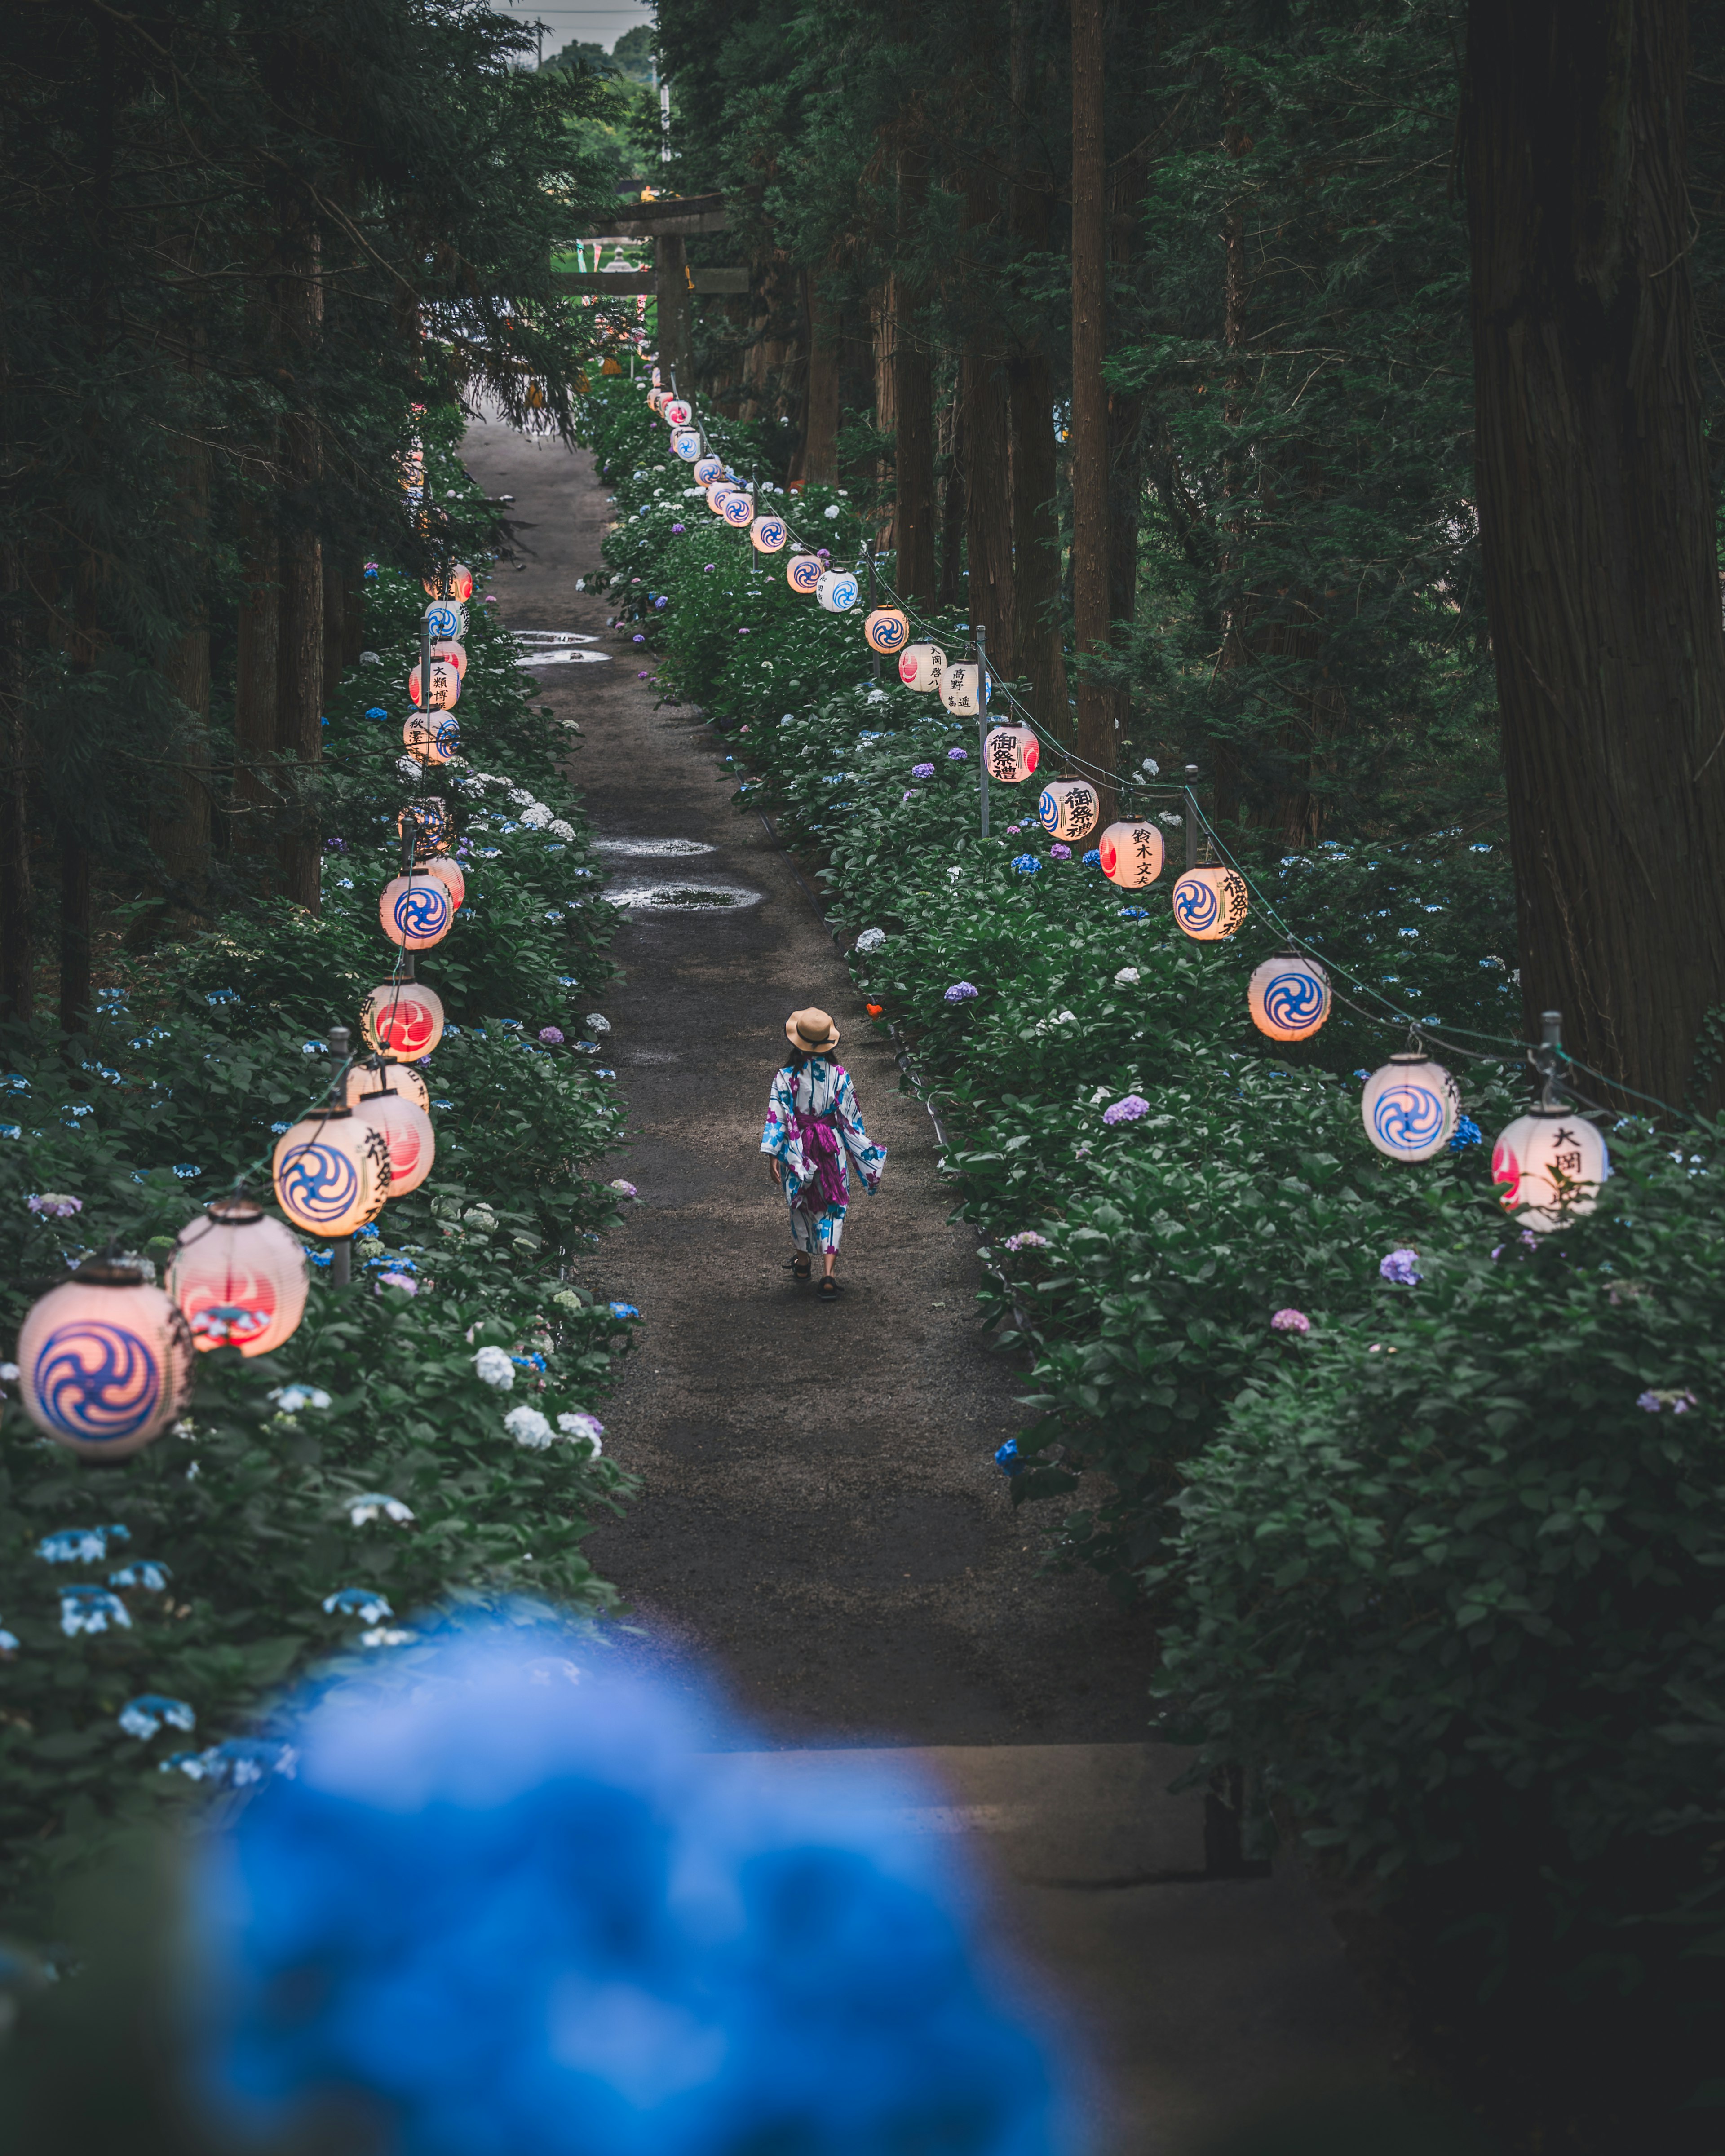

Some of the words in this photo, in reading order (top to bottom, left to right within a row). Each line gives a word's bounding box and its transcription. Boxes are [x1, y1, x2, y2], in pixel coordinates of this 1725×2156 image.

[991, 732, 1017, 779] 御祭禮
[1065, 788, 1093, 837] 御祭禮
[1131, 828, 1153, 885] 鈴木文夫
